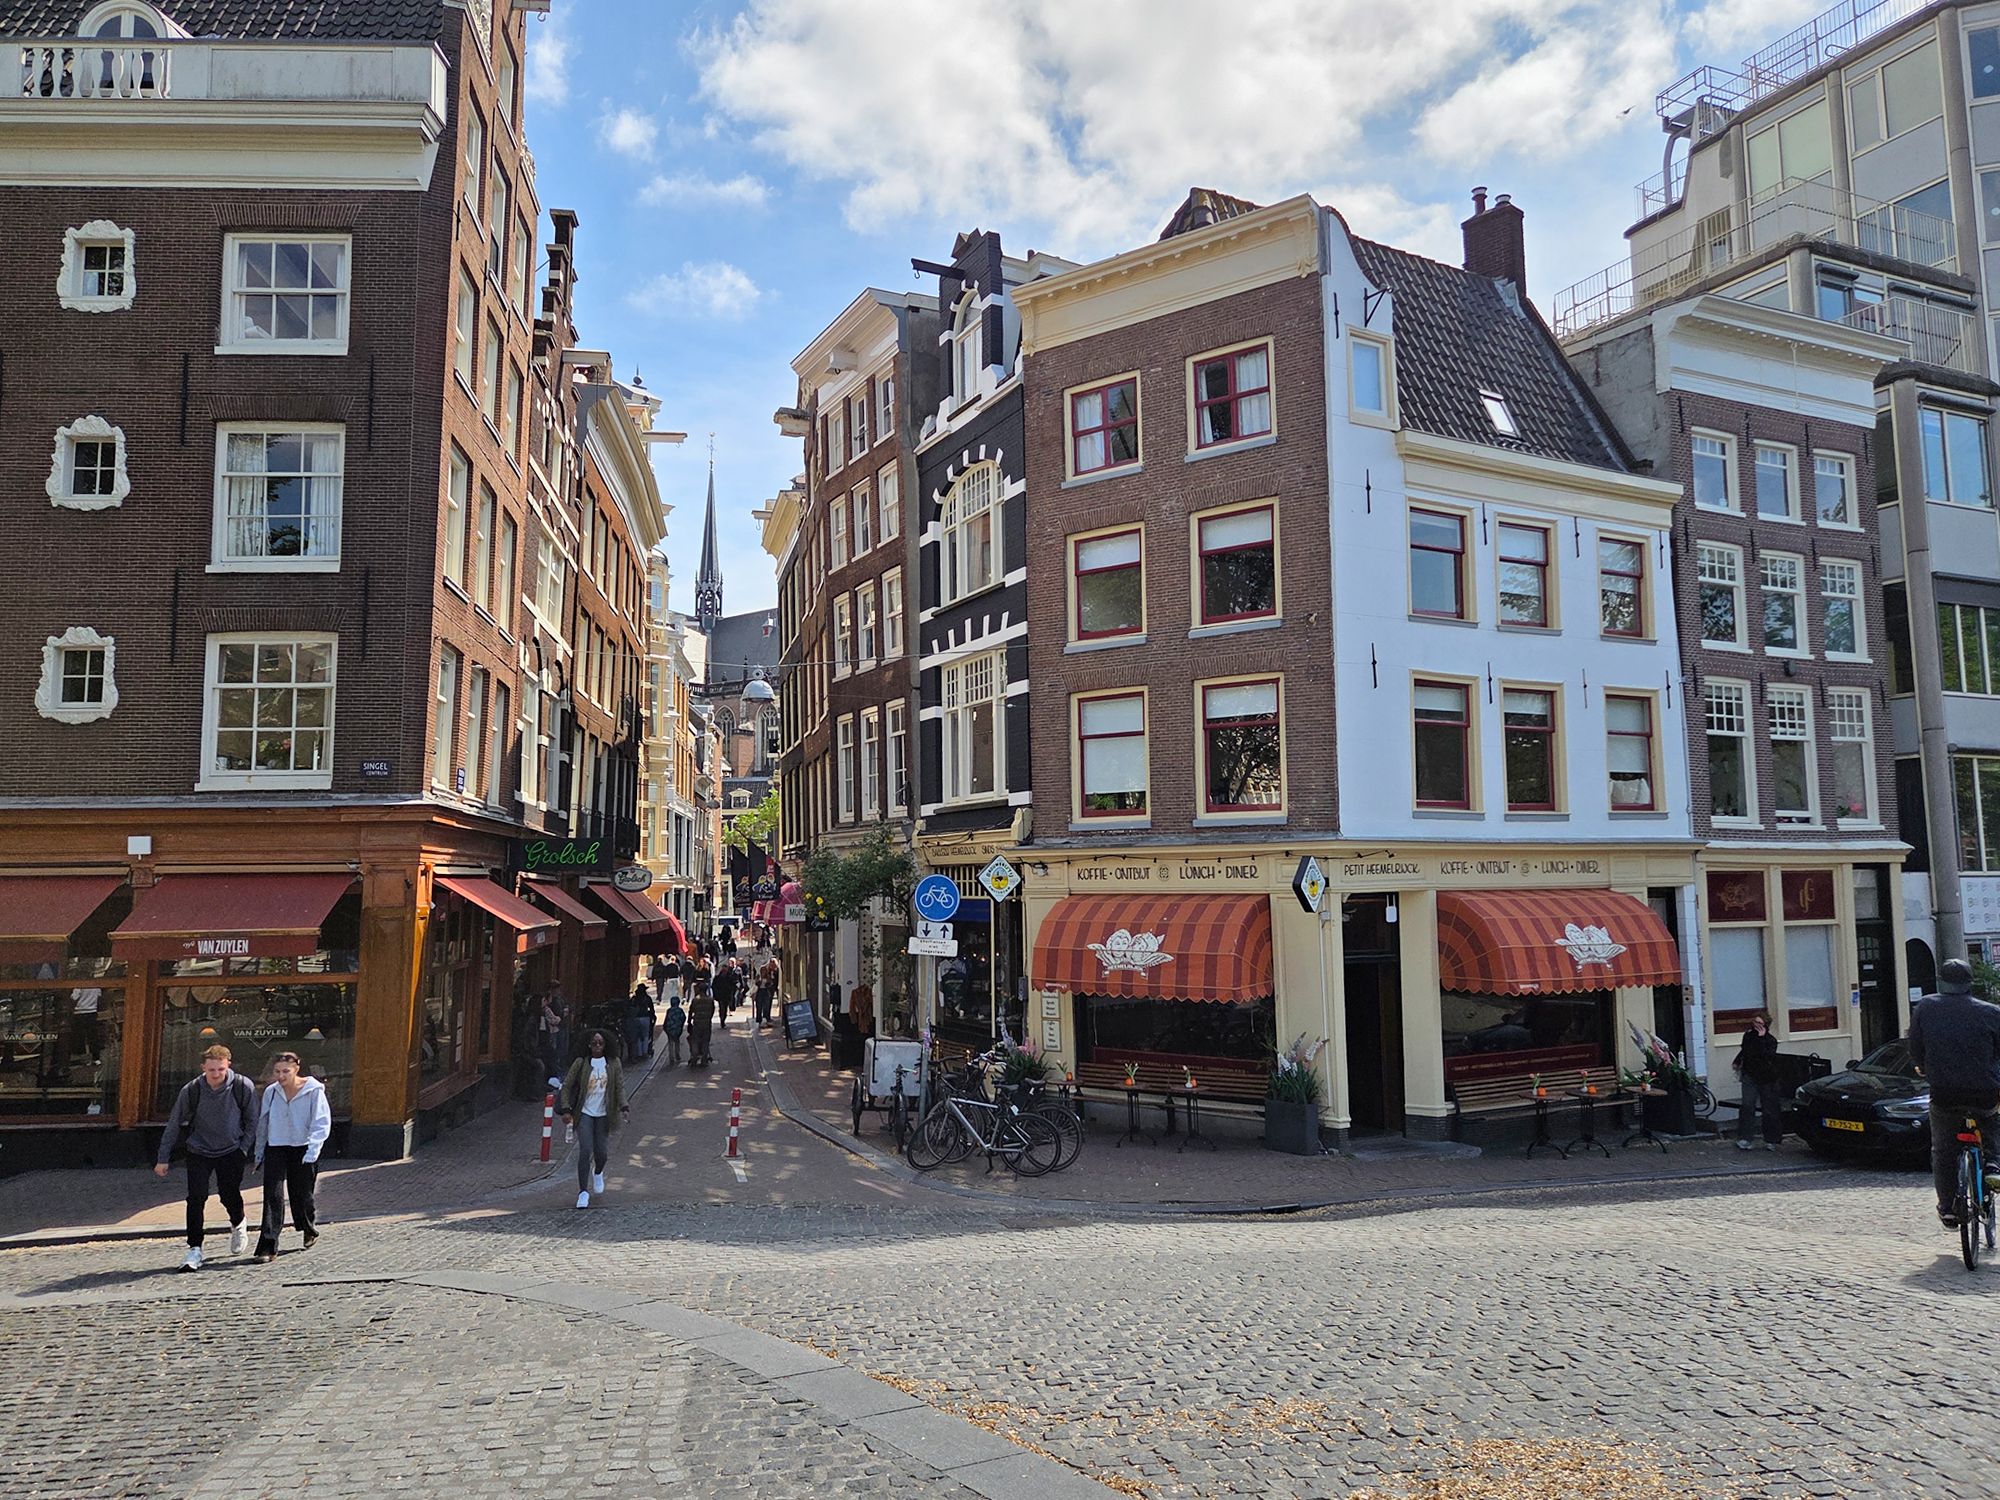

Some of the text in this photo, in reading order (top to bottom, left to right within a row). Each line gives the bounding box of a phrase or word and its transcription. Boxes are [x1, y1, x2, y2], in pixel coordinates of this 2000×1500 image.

[363, 762, 388, 770] SINGEL
[525, 841, 600, 869] Grolsch
[1077, 865, 1259, 880] KOFFIE ONTBIJT LUNCH DINER
[1344, 864, 1365, 876] PETIT
[1440, 860, 1600, 874] KOFFIE ONTBIJT LUNCH DINER
[198, 940, 214, 954] VAN
[215, 939, 248, 954] ZUYLEN
